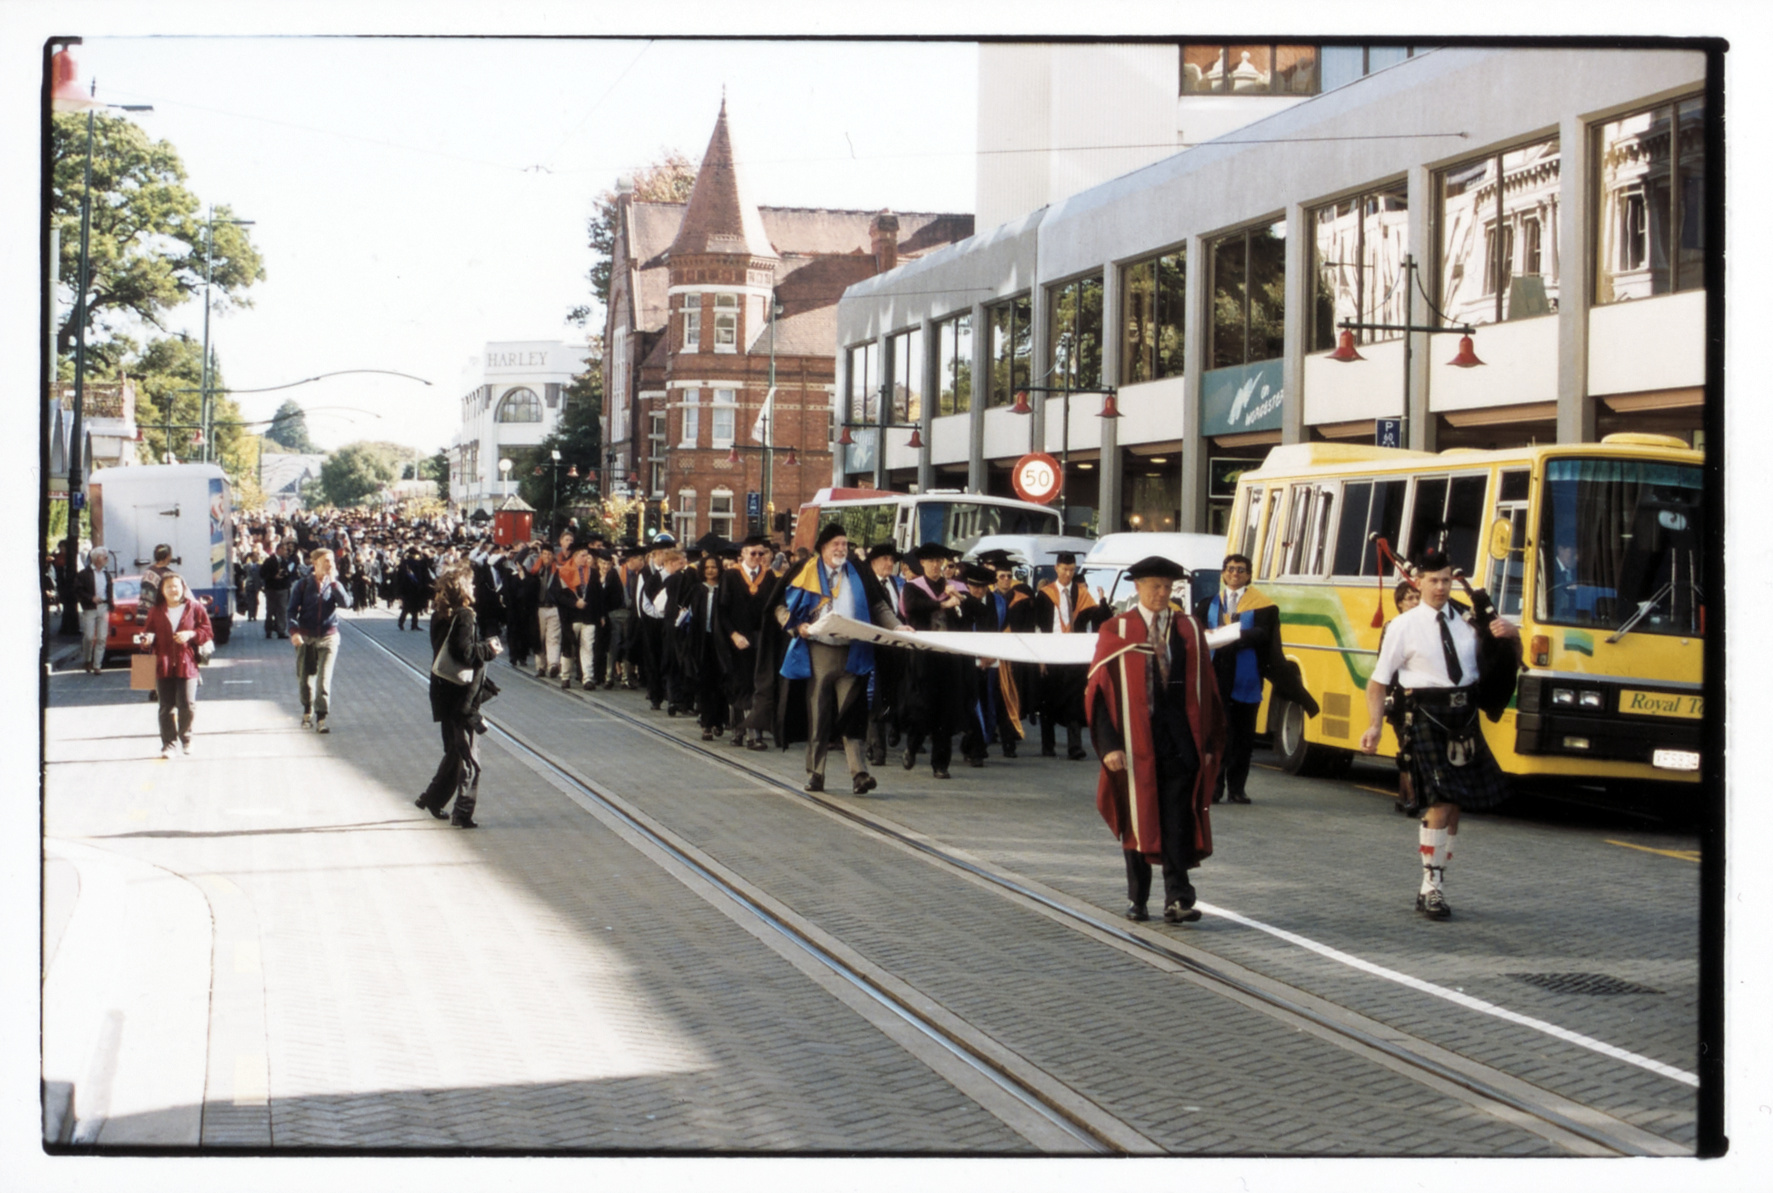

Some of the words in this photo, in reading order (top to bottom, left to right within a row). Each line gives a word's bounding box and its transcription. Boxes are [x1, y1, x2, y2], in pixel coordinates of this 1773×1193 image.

[487, 351, 548, 367] HARLEY
[1385, 421, 1394, 432] P
[1025, 470, 1050, 487] 50
[1630, 692, 1682, 715] Royal
